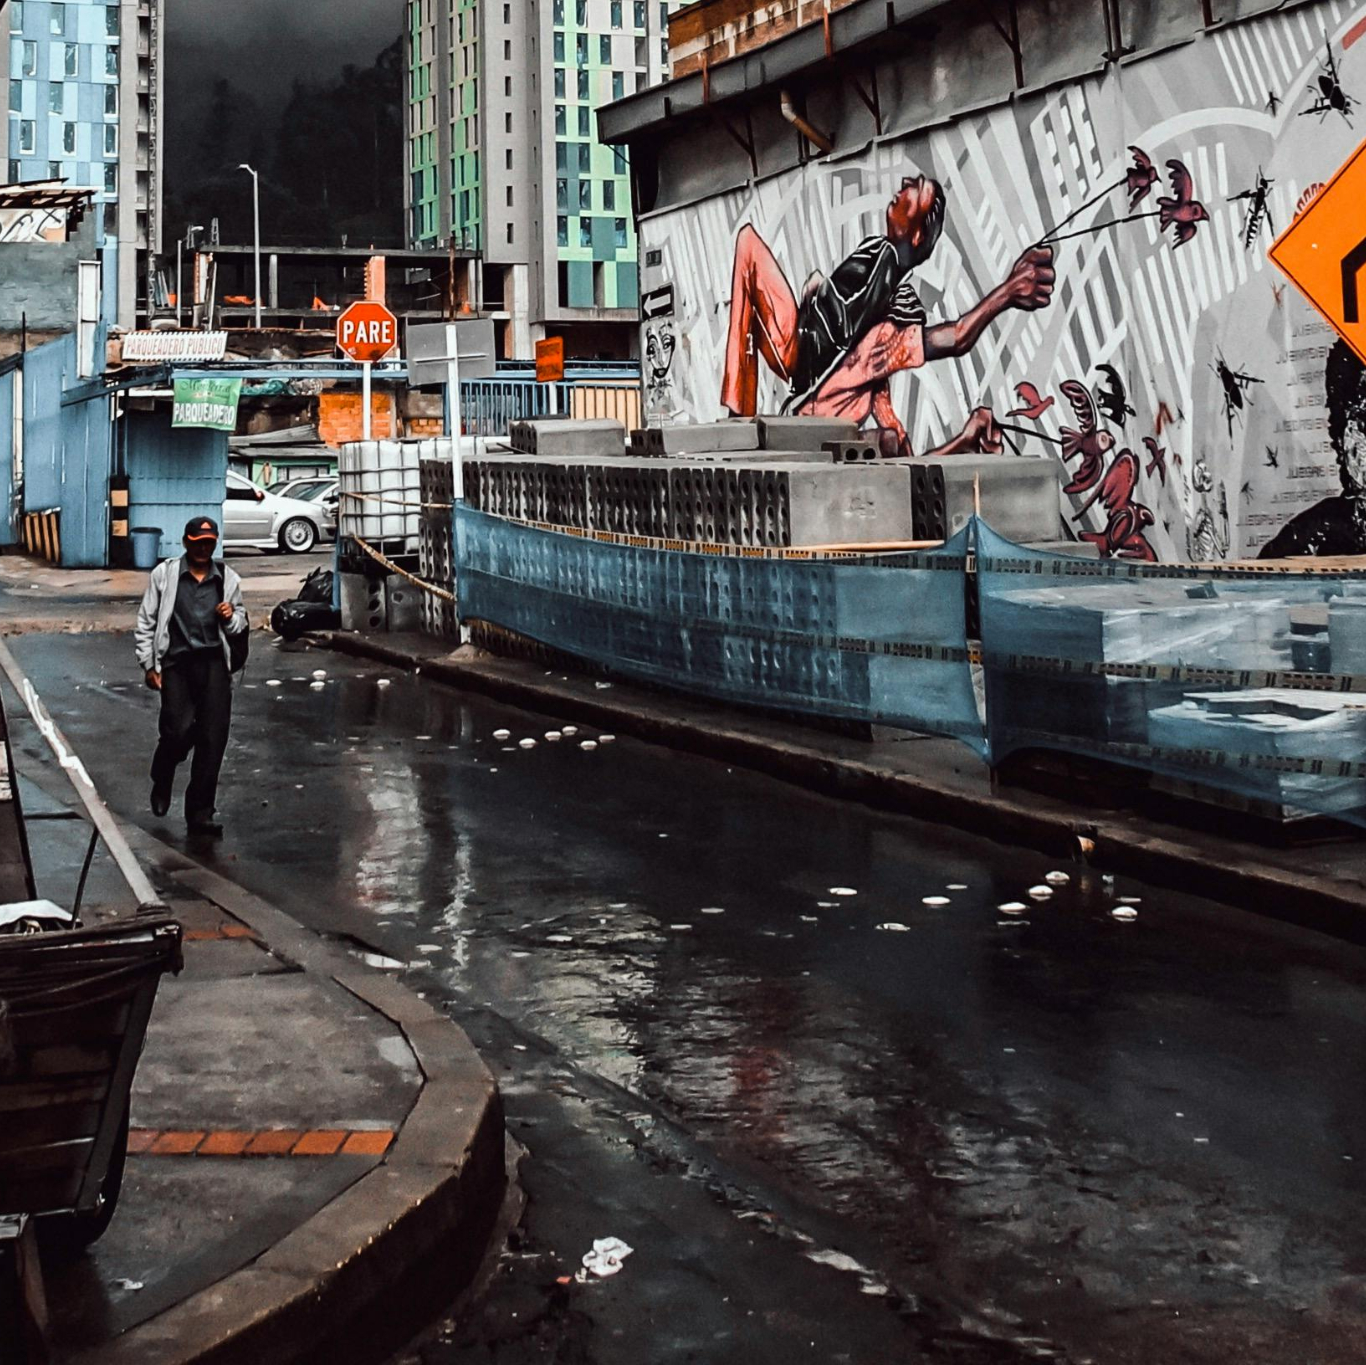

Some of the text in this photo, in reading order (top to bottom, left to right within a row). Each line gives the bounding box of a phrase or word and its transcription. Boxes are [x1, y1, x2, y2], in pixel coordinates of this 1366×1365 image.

[342, 320, 392, 343] PARE
[126, 337, 224, 356] PARQUEADERO PUBLICO
[174, 402, 236, 425] PARQUEADERO
